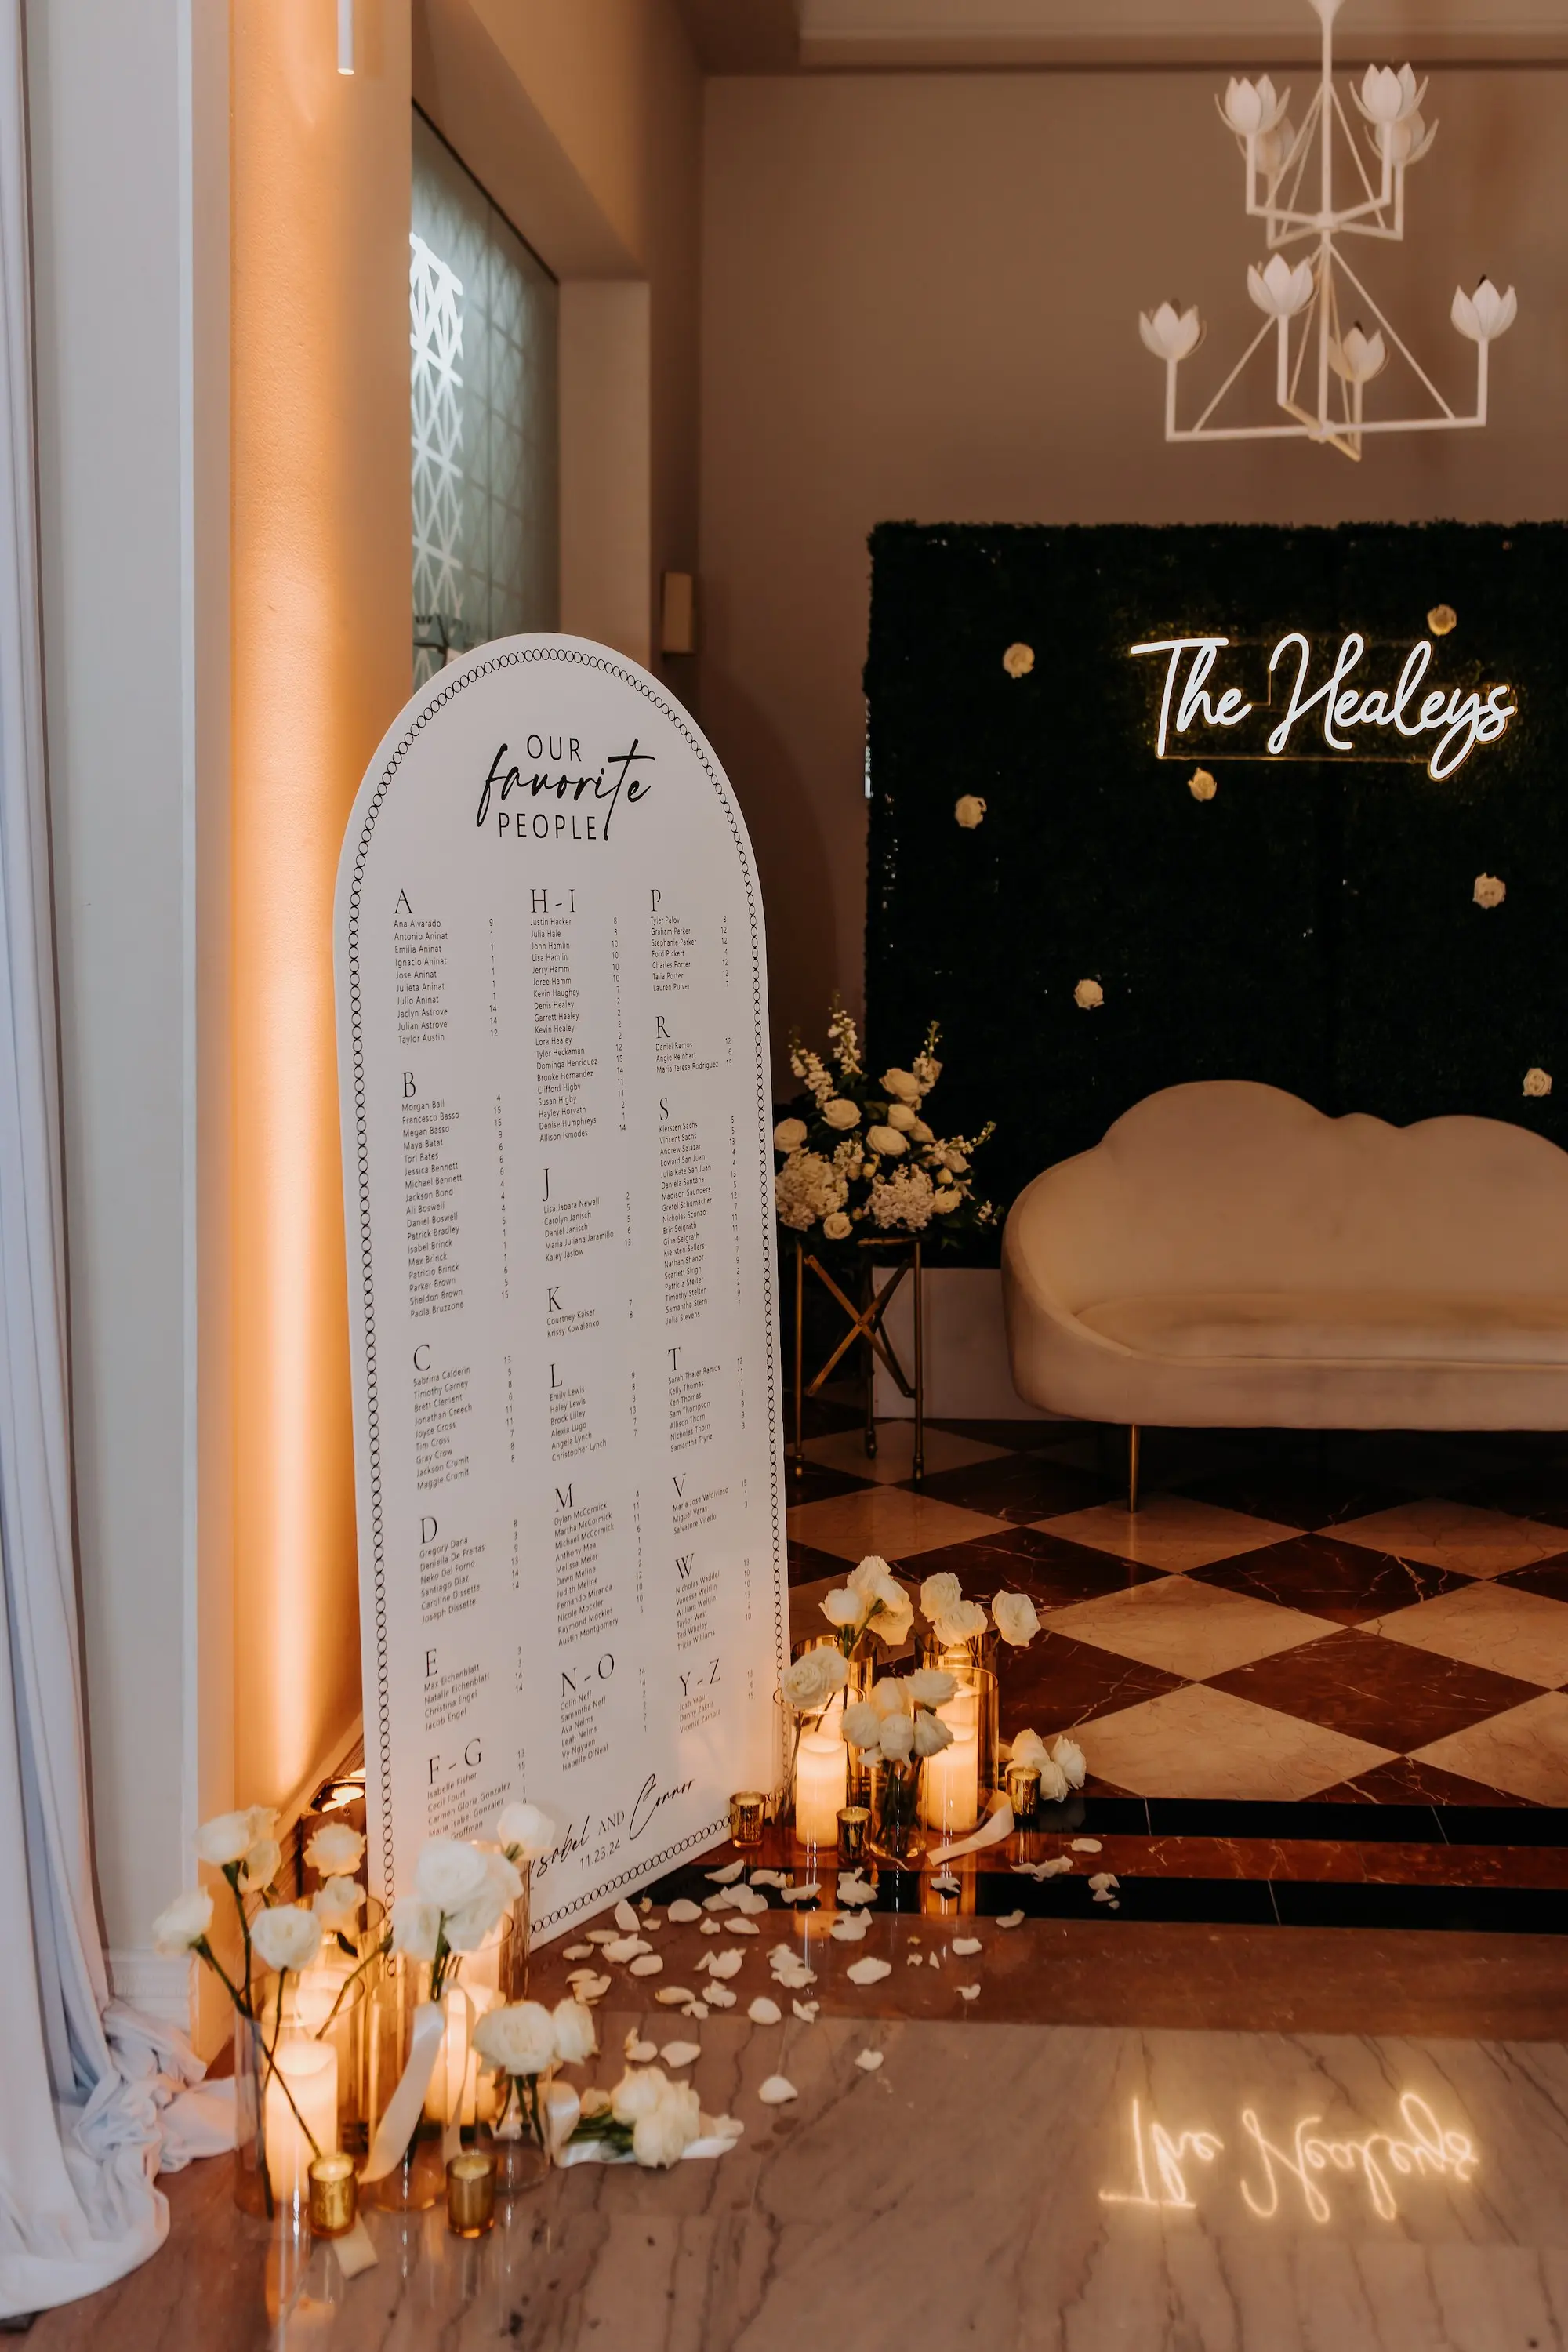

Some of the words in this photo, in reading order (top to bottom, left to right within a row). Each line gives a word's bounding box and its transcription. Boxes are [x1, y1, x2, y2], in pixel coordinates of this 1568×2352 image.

[1130, 637, 1253, 757] The
[1268, 633, 1516, 780] Healeys
[527, 734, 582, 762] OUR
[477, 738, 655, 841] favorite
[499, 812, 596, 840] PEOPLE
[394, 887, 413, 914] A
[530, 889, 549, 913] H
[569, 889, 575, 913] I
[651, 889, 661, 912] P
[553, 989, 579, 998] Haughey
[397, 1009, 419, 1019] Jaclyn
[398, 1022, 419, 1031] Julian
[655, 1015, 670, 1039] R
[398, 1036, 419, 1045] Taylor
[552, 1036, 572, 1045] Healey
[536, 1050, 550, 1058] Tyler
[554, 1047, 585, 1057] Heckaman
[537, 1061, 564, 1070] Dominga
[568, 1058, 597, 1067] Henriquez
[692, 1062, 718, 1071] Rodriguez
[401, 1071, 416, 1098] B
[561, 1071, 593, 1080] Hernandez
[401, 1103, 429, 1112] Morgan
[432, 1099, 445, 1109] Ball
[559, 1096, 576, 1105] Higby
[659, 1098, 669, 1121] S
[402, 1114, 437, 1124] Francesco
[539, 1121, 560, 1131] Denise
[563, 1117, 596, 1128] Humphreys
[659, 1124, 681, 1133] Kiersten
[403, 1127, 427, 1138] Megan
[563, 1130, 588, 1139] Ismodes
[405, 1167, 428, 1176] Jessica
[431, 1163, 458, 1173] Bennett
[405, 1178, 433, 1189] Michael
[435, 1174, 463, 1185] Bennett
[542, 1168, 550, 1202] J
[406, 1192, 433, 1203] Jackson
[435, 1187, 453, 1198] Bond
[662, 1191, 685, 1200] Madison
[687, 1186, 710, 1196] Saunders
[407, 1218, 430, 1228] Daniel
[432, 1212, 458, 1224] Boswell
[544, 1216, 568, 1226] Carolyn
[570, 1211, 591, 1221] Janisch
[545, 1228, 564, 1238] Daniel
[567, 1224, 588, 1234] Janisch
[546, 1241, 563, 1250] Maria
[565, 1235, 585, 1247] Juliana
[588, 1230, 614, 1243] Jaramillo
[409, 1282, 431, 1292] Parker
[434, 1277, 456, 1288] Brown
[410, 1294, 438, 1306] Sheldon
[441, 1289, 463, 1300] Brown
[547, 1286, 563, 1312] K
[411, 1308, 430, 1318] Paola
[433, 1301, 464, 1314] Bruzzone
[547, 1314, 575, 1326] Courtney
[577, 1308, 595, 1319] Kaiser
[547, 1327, 565, 1338] Krissy
[568, 1320, 600, 1334] Kowalenko
[414, 1344, 431, 1371] C
[668, 1347, 681, 1372] T
[550, 1363, 563, 1388] L
[414, 1386, 442, 1399] Timothy
[445, 1381, 469, 1392] Carney
[550, 1391, 566, 1402] Emily
[568, 1386, 585, 1396] Lewis
[669, 1386, 681, 1396] Kelly
[684, 1381, 704, 1391] Thomas
[415, 1411, 446, 1426] Jonathan
[448, 1404, 472, 1417] Creech
[670, 1418, 688, 1429] Allison
[690, 1414, 706, 1424] Thorn
[552, 1438, 572, 1450] Angela
[575, 1432, 592, 1445] Lynch
[552, 1444, 588, 1462] Christopher
[590, 1439, 607, 1452] Lynch
[673, 1473, 686, 1497] V
[555, 1483, 574, 1513] M
[420, 1516, 437, 1544] D
[555, 1536, 579, 1550] Michael
[582, 1523, 614, 1541] McCormick
[420, 1544, 448, 1559] Gregory
[451, 1537, 468, 1548] Dana
[675, 1553, 695, 1580] W
[422, 1594, 450, 1610] Caroline
[453, 1584, 480, 1599] Dissette
[558, 1610, 577, 1622] Nicole
[579, 1600, 604, 1613] Mockler
[425, 1648, 438, 1678] E
[424, 1682, 438, 1692] Max
[441, 1664, 480, 1686] Eichenblatt
[561, 1668, 577, 1697] N
[598, 1653, 615, 1680] O
[679, 1671, 691, 1697] Y
[710, 1657, 720, 1685] Z
[428, 1755, 441, 1786] F
[465, 1738, 482, 1767] G
[598, 1810, 626, 1836] AND
[629, 1773, 696, 1841] Connor
[579, 1838, 621, 1871] 11.23.24
